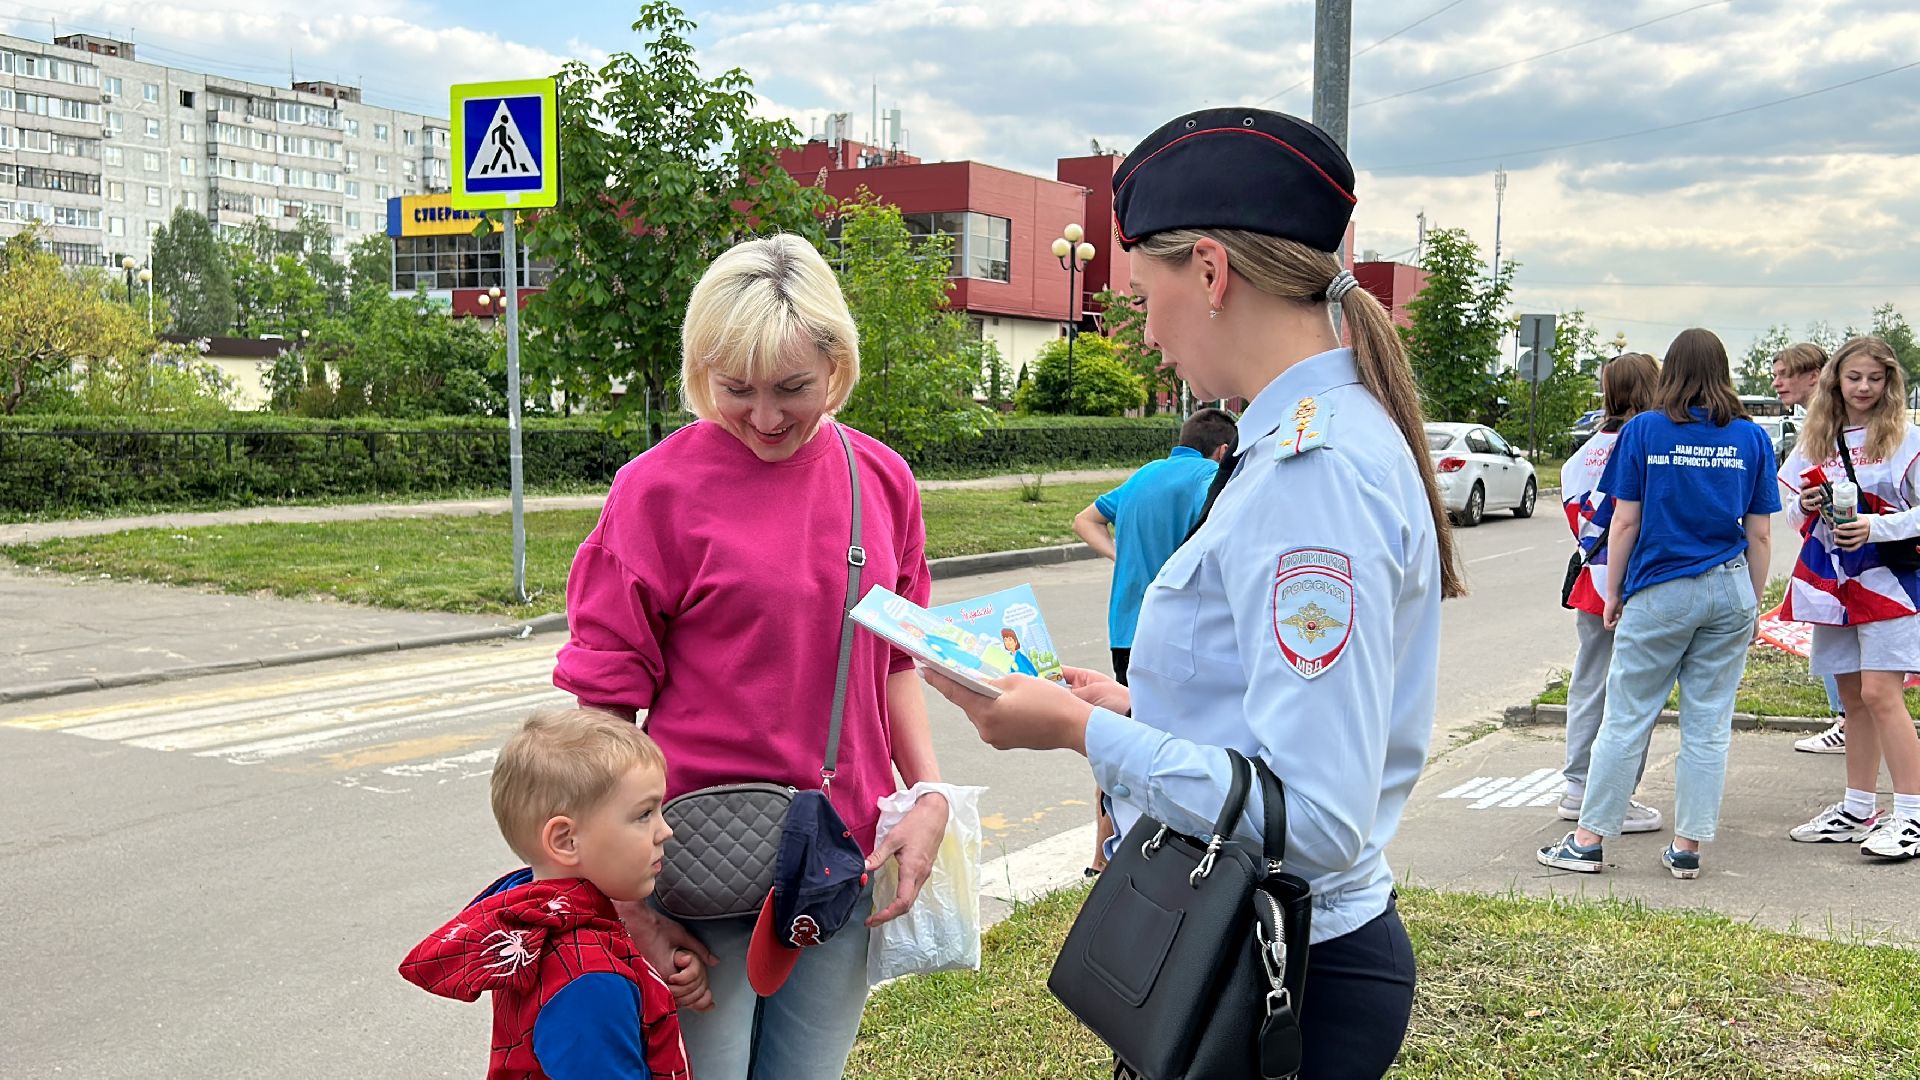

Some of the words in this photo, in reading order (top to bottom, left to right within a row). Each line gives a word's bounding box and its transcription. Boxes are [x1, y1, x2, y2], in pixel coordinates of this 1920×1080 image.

[1647, 454, 1670, 465] НАША
[1672, 455, 1710, 468] ВЕРНОСТЬ
[1693, 446, 1716, 457] СИЛУ
[1716, 446, 1738, 457] ДАЁТ
[1280, 552, 1348, 573] ПОЛИЦИЯ
[1281, 579, 1346, 603] РОССИЯ
[1295, 656, 1323, 676] МВД
